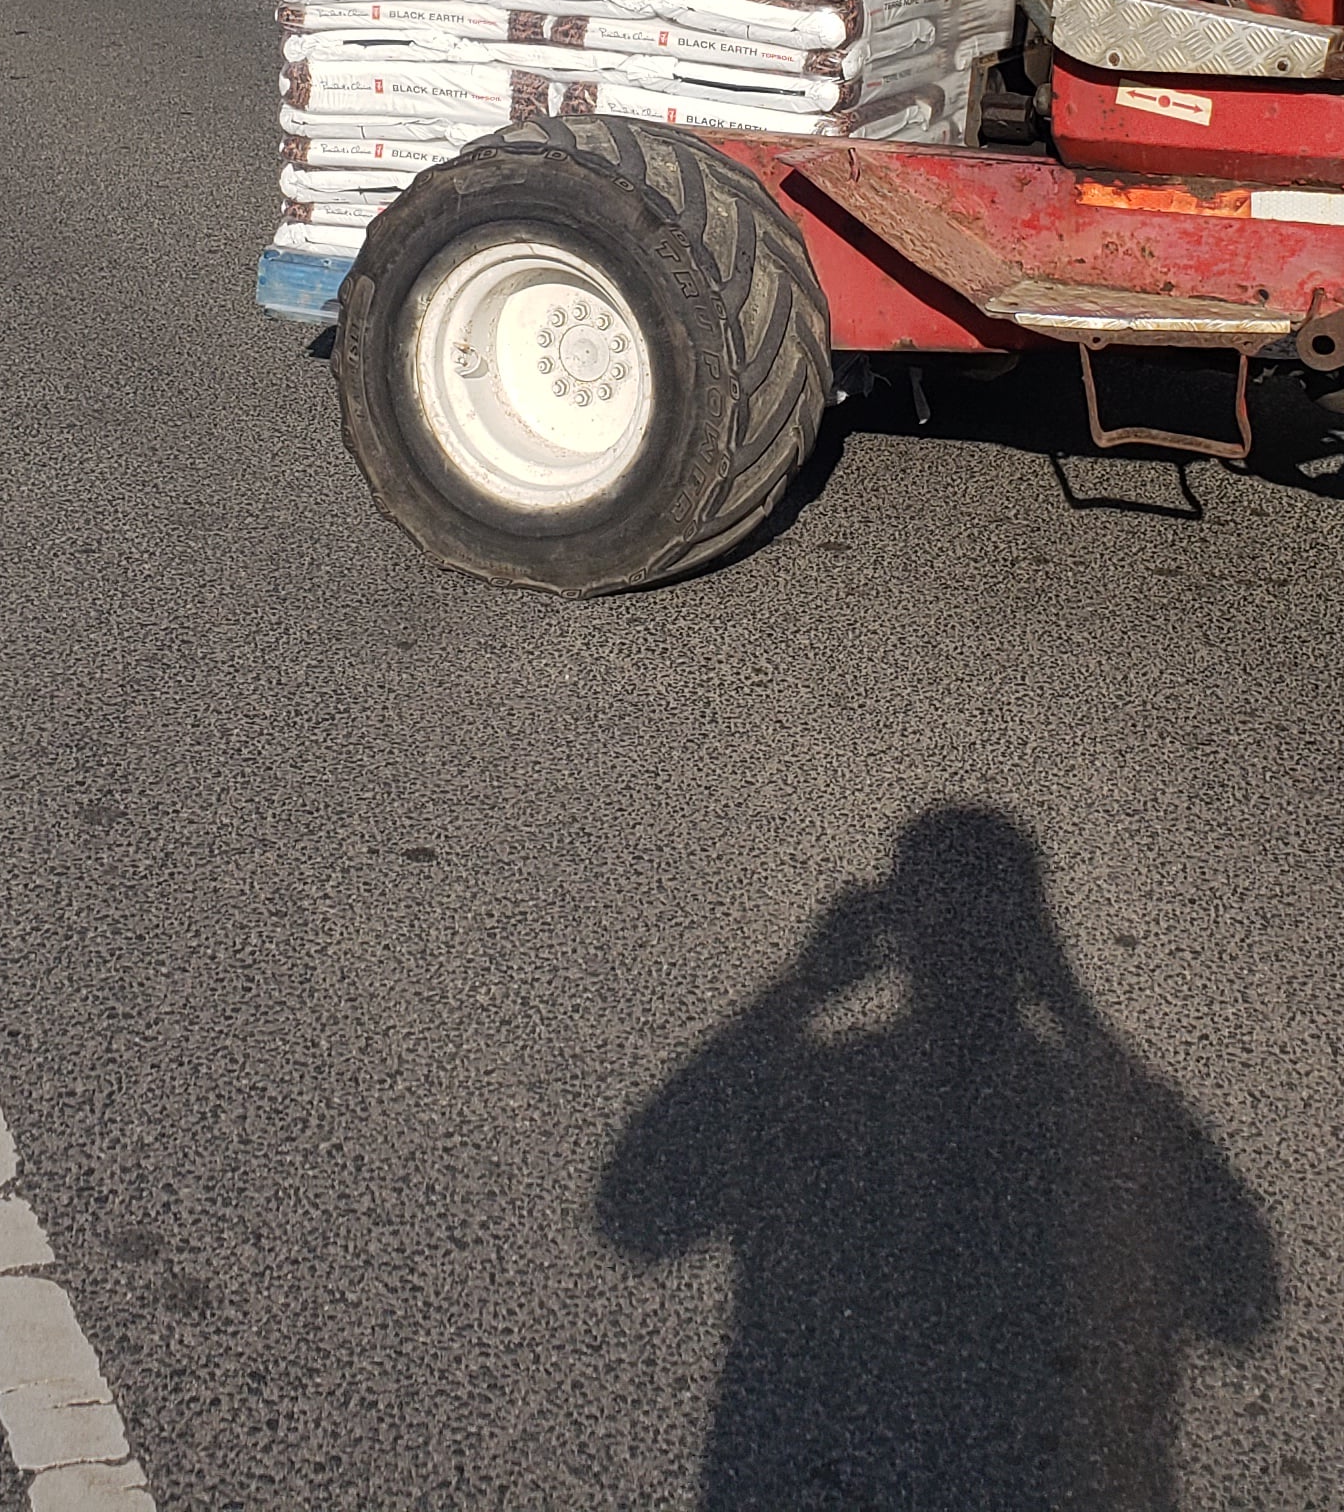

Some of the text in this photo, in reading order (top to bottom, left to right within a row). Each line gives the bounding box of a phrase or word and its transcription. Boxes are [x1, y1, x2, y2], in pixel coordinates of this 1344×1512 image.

[389, 11, 425, 20] BLACK
[428, 13, 464, 23] EARTH
[678, 38, 716, 50] BLACK
[720, 43, 758, 56] EARTH
[392, 84, 428, 94] BLACK
[432, 87, 468, 99] EARTH
[686, 115, 725, 129] BLACK
[391, 149, 427, 161] BLACK
